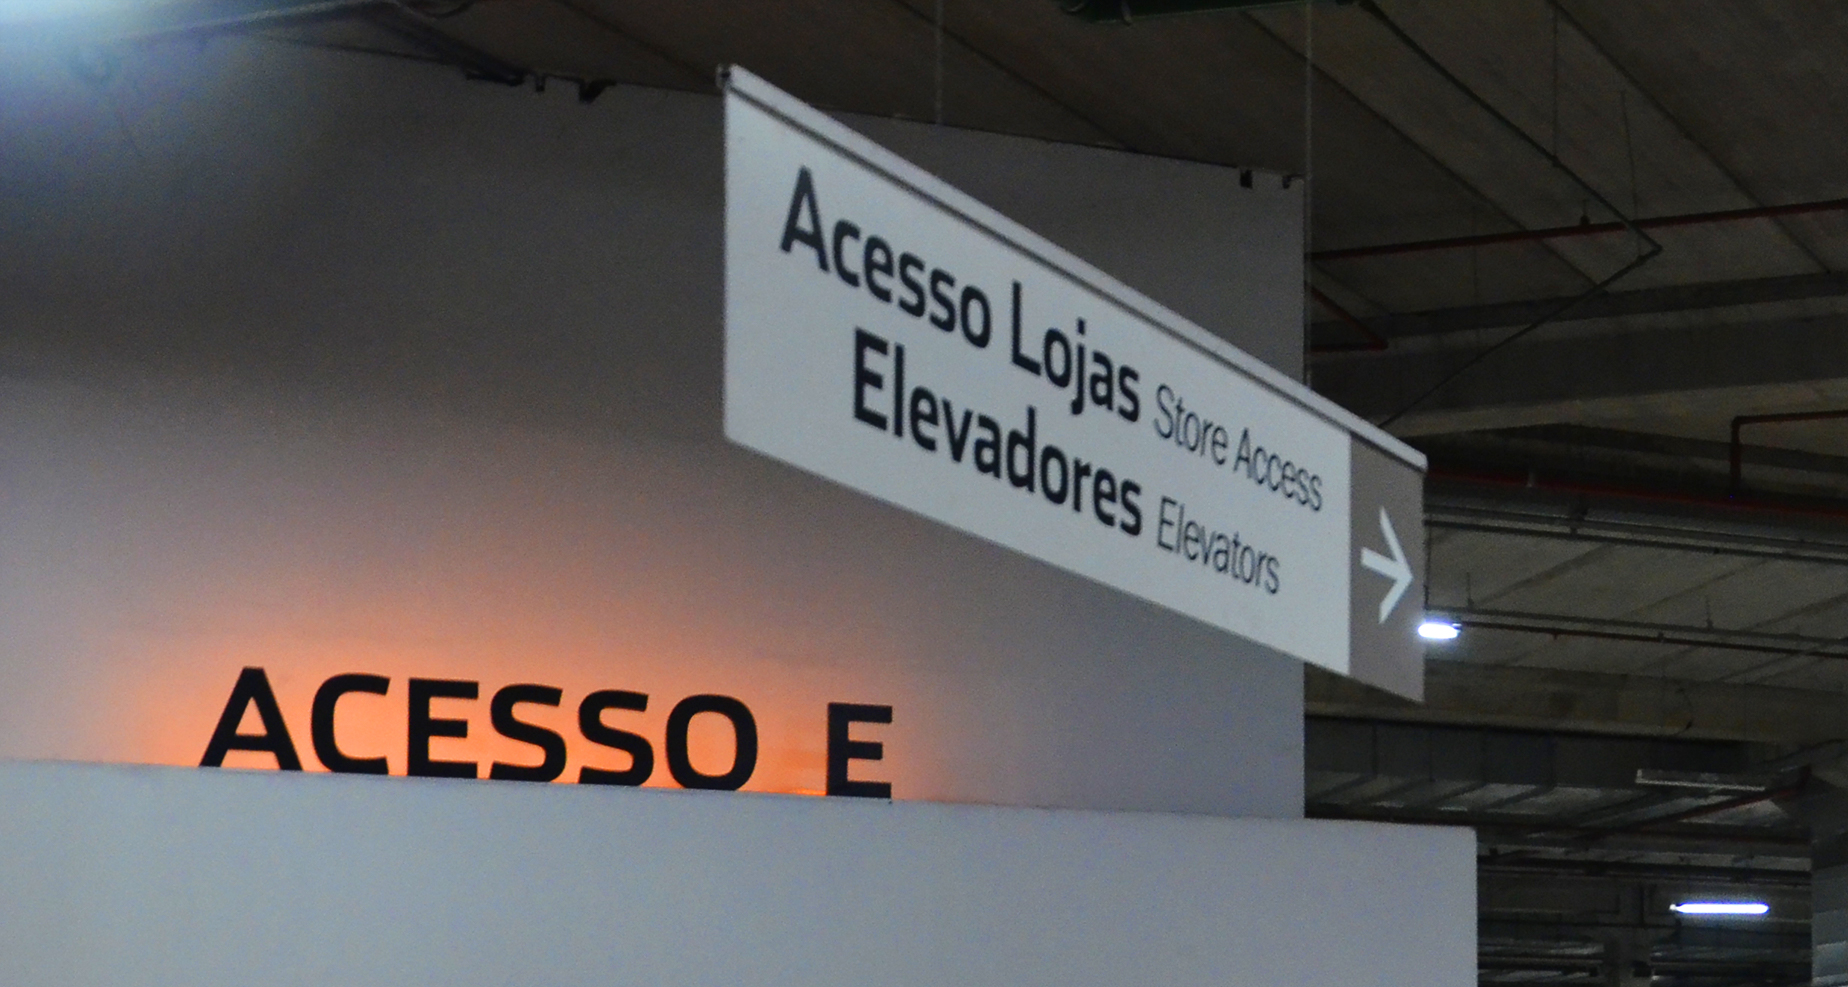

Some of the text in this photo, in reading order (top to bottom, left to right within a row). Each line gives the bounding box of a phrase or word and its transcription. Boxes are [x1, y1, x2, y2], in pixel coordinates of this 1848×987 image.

[780, 165, 1323, 513] Acesso Lojas Store Access
[852, 327, 1281, 596] Elevadores Elevators
[198, 666, 893, 799] ACESSO E
